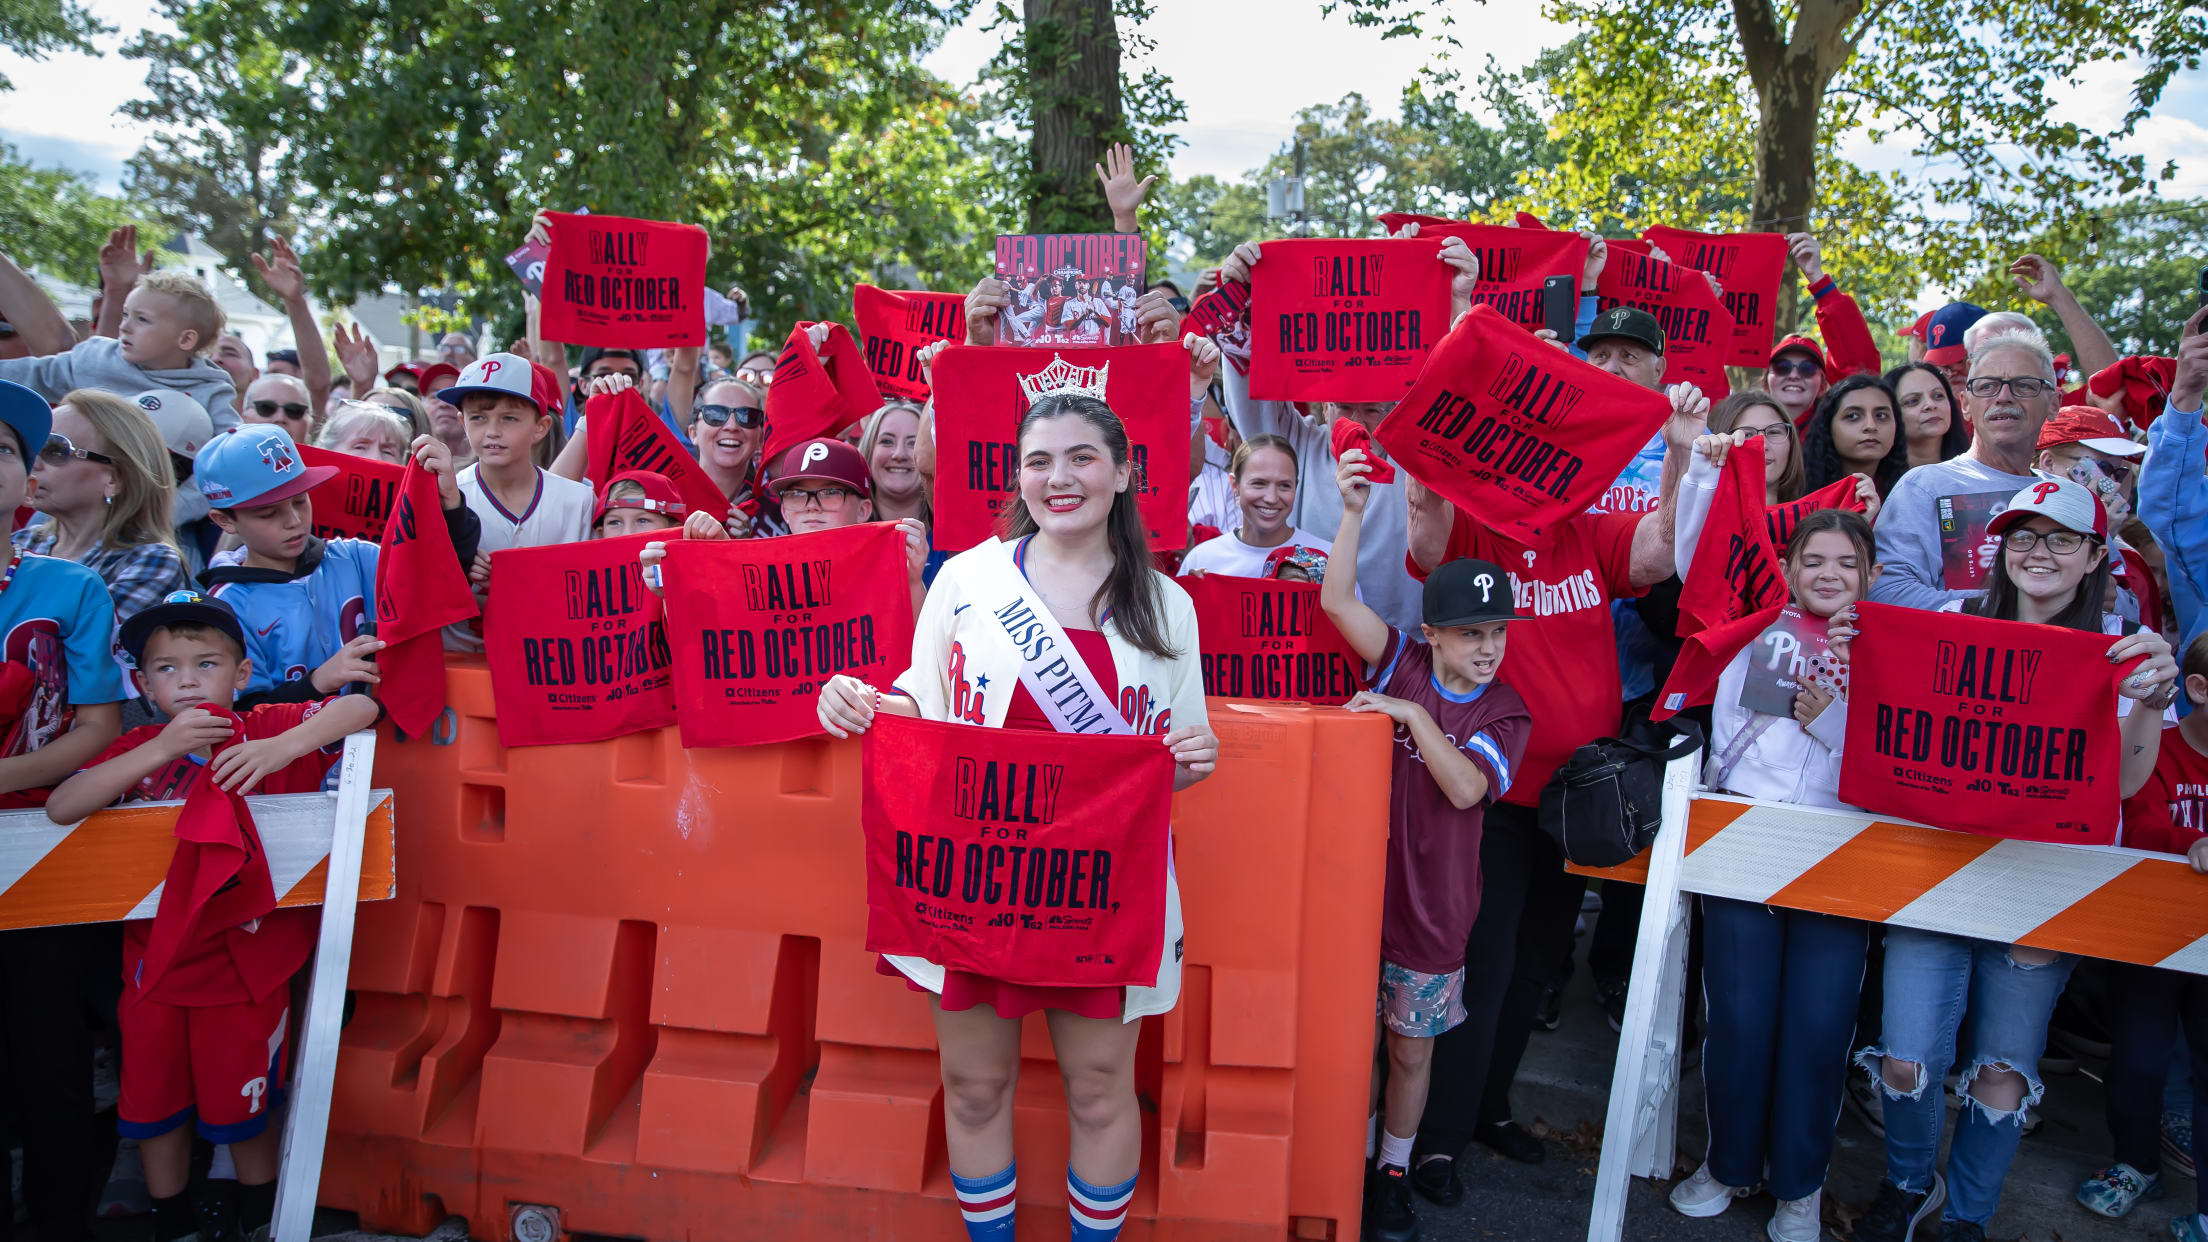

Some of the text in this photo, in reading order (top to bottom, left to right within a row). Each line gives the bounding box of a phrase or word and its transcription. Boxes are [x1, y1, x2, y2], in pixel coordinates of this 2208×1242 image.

[590, 230, 648, 266] RALLY
[996, 234, 1142, 279] RED OCTOBER
[1475, 248, 1521, 283] ALLY
[1683, 241, 1739, 280] RALLY
[565, 269, 680, 311] RED OCTOBER
[608, 267, 633, 276] FOR
[1314, 255, 1384, 298] RALLY
[1621, 251, 1682, 294] RALLY
[1334, 300, 1365, 308] FOR
[1635, 292, 1663, 302] FOR
[1280, 313, 1318, 353] RED
[1326, 310, 1421, 352] OCTOBER
[1931, 323, 1946, 346] P
[481, 361, 502, 383] P
[867, 336, 904, 377] RED
[1488, 352, 1585, 430] RALLY
[1500, 408, 1534, 431] FOR
[800, 442, 829, 472] P
[1416, 389, 1477, 441] RED
[1462, 416, 1584, 499] OCTOBER
[2033, 482, 2060, 505] P
[1523, 550, 1537, 568] P
[565, 561, 644, 620] RALLY
[742, 560, 831, 611] RALLY
[1473, 573, 1495, 603] P
[591, 619, 627, 631] FOR
[774, 612, 812, 624] FOR
[993, 596, 1056, 662] MISS
[1241, 590, 1318, 637] RALLY
[1781, 608, 1801, 619] OYOTA
[524, 637, 576, 686] RED
[703, 629, 756, 680] RED
[765, 614, 877, 679] OCTOBER
[1262, 640, 1294, 649] FOR
[1202, 653, 1243, 697] RED
[1933, 639, 2042, 705] RALLY
[558, 693, 597, 703] Citizens
[736, 687, 780, 698] Citizens
[1958, 702, 2004, 717] FOR
[1876, 703, 1933, 763] RED
[1940, 715, 2088, 782] OCTOBER
[954, 756, 1064, 825] RALLY
[1905, 769, 1953, 787] Citizens
[980, 826, 1028, 841] FOR
[895, 830, 954, 898] RED
[962, 843, 1113, 910] OCTOBER
[241, 1076, 267, 1114] P
